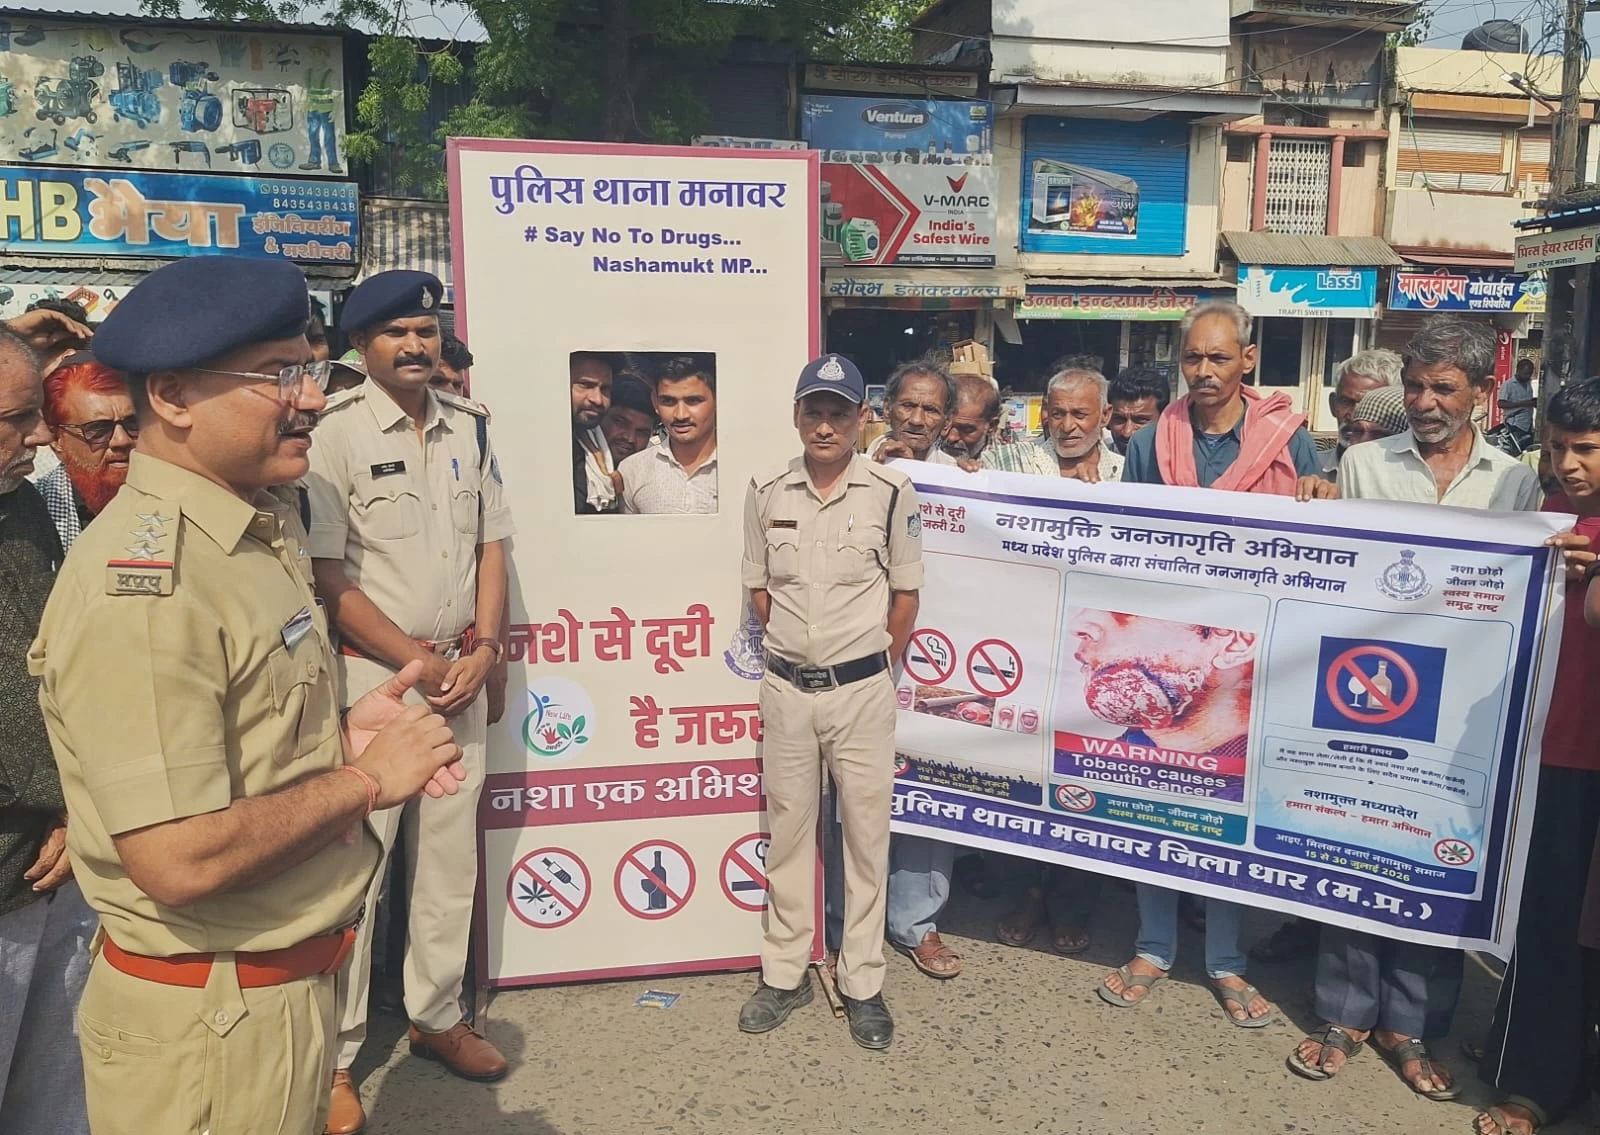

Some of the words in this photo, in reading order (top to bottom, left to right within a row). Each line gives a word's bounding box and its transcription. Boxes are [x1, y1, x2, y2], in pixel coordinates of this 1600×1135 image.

[866, 109, 924, 124] Ventura
[272, 185, 354, 198] 9993438438
[490, 164, 585, 215] पुलिस
[593, 178, 671, 208] थाना
[678, 181, 787, 208] मनावर
[273, 198, 356, 212] 8435438438
[924, 194, 990, 208] V-MARC
[84, 177, 246, 248] भैया
[929, 219, 975, 231] India's
[545, 227, 585, 247] Say
[592, 227, 621, 244] No
[628, 228, 654, 245] To
[661, 228, 742, 248] Drugs...
[913, 233, 956, 245] Safest
[959, 234, 990, 245] Wire
[1541, 240, 1561, 256] हेयर
[1562, 234, 1594, 251] स्टाईल
[593, 257, 714, 273] Nashamukt
[721, 258, 769, 275] MP...
[829, 278, 884, 296] सौरभ
[1318, 273, 1361, 289] Lassi
[1469, 277, 1515, 297] मोबाईल
[1023, 292, 1074, 309] उन्नत
[1278, 308, 1303, 316] TRAPTI
[1305, 309, 1333, 317] SWEETS
[919, 502, 932, 515] शे
[935, 503, 945, 516] से
[947, 506, 966, 522] दूरी
[950, 523, 965, 533] 2.0
[996, 512, 1103, 541] नशामुक्ति
[1110, 525, 1236, 556] जनजागृति
[1244, 537, 1359, 567] अभियान
[1002, 540, 1027, 553] मध्य
[1032, 541, 1063, 558] प्रदेश
[1068, 545, 1106, 566] पुलिस
[1110, 553, 1141, 568] द्वारा
[1144, 553, 1201, 575] संचालित
[1204, 566, 1279, 587] जनजागृति
[1282, 571, 1346, 593] अभियान
[1450, 565, 1474, 574] नशा
[1446, 576, 1476, 586] जीवन
[1473, 591, 1505, 601] समाज
[506, 609, 583, 664] नशे
[590, 607, 636, 661] से
[642, 604, 715, 675] दूरी
[629, 696, 663, 749] है
[1082, 738, 1219, 771] WARNING
[1343, 743, 1367, 752] हमारी
[1072, 753, 1151, 775] Tobacco
[1157, 768, 1227, 788] causes
[1083, 769, 1142, 785] mouth
[1148, 780, 1215, 797] cancer
[490, 783, 576, 812] नशा
[585, 779, 646, 811] एक
[1107, 798, 1128, 808] नशा
[1167, 808, 1197, 819] जीवन
[1360, 798, 1418, 820] मध्यप्रदेश
[1286, 800, 1313, 812] हमारा
[1315, 804, 1347, 818] संकल्प
[1362, 814, 1389, 827] हमारा
[1392, 821, 1432, 839] अभियान
[890, 791, 965, 821] पुलिस
[972, 804, 1045, 836] थाना
[1049, 822, 1152, 858] मनावर
[1158, 840, 1240, 876] जिला
[1248, 861, 1308, 891] धार
[1316, 878, 1433, 920] (म.प्र.)
[1306, 838, 1342, 854] मिलकर
[1372, 854, 1412, 871] नशामुक्त
[1414, 866, 1446, 879] समाज
[1305, 850, 1317, 858] 15
[1320, 850, 1329, 861] से
[1332, 857, 1348, 865] 30
[1351, 859, 1380, 874] जुलाई
[1381, 868, 1411, 882] 2026
